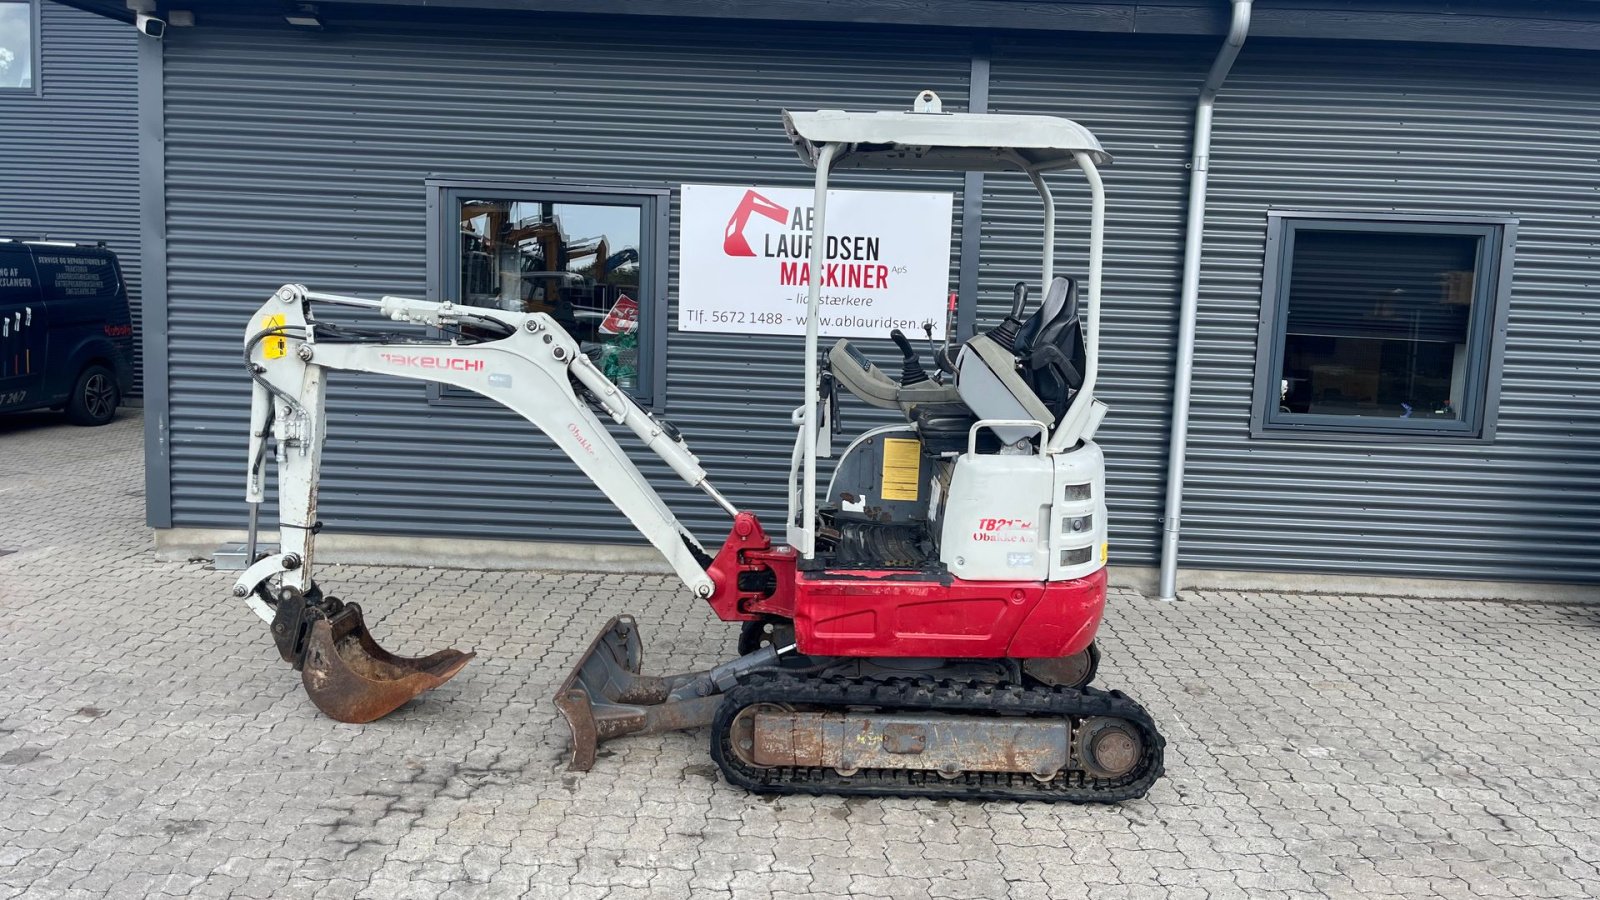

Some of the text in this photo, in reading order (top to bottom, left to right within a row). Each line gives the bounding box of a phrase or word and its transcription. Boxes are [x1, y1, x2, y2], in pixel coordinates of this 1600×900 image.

[765, 233, 879, 261] LAURDSEN
[10, 268, 18, 277] AF
[892, 266, 907, 275] ApS
[687, 309, 707, 325] Tlf.
[712, 311, 745, 324] 5672
[749, 312, 783, 325] 1488
[796, 315, 938, 330] ww.ablauridsen.dk
